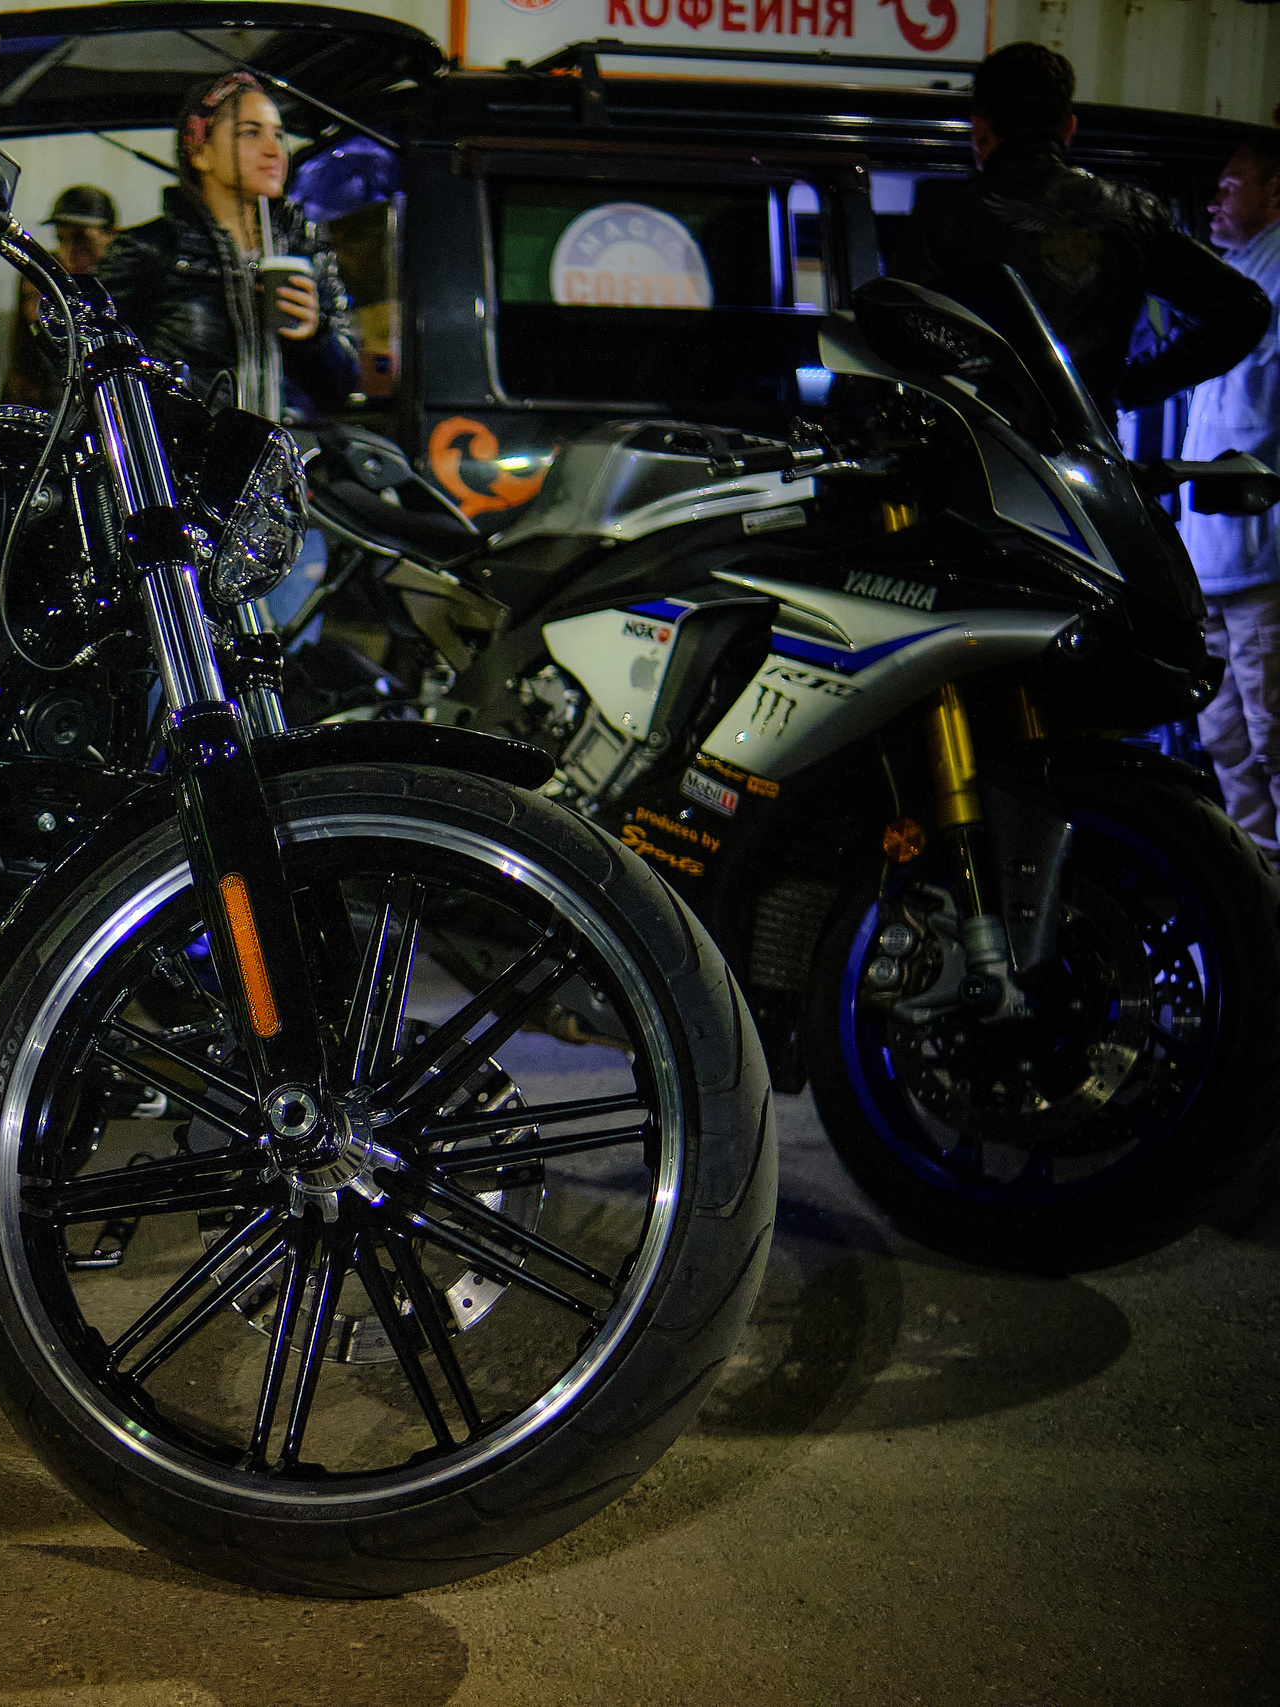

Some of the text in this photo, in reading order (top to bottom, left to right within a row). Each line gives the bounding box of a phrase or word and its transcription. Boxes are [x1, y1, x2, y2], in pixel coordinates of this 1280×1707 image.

[843, 569, 939, 611] YAMAHA
[623, 620, 657, 640] NGK
[683, 771, 722, 800] Mobil
[635, 806, 720, 853] produced by
